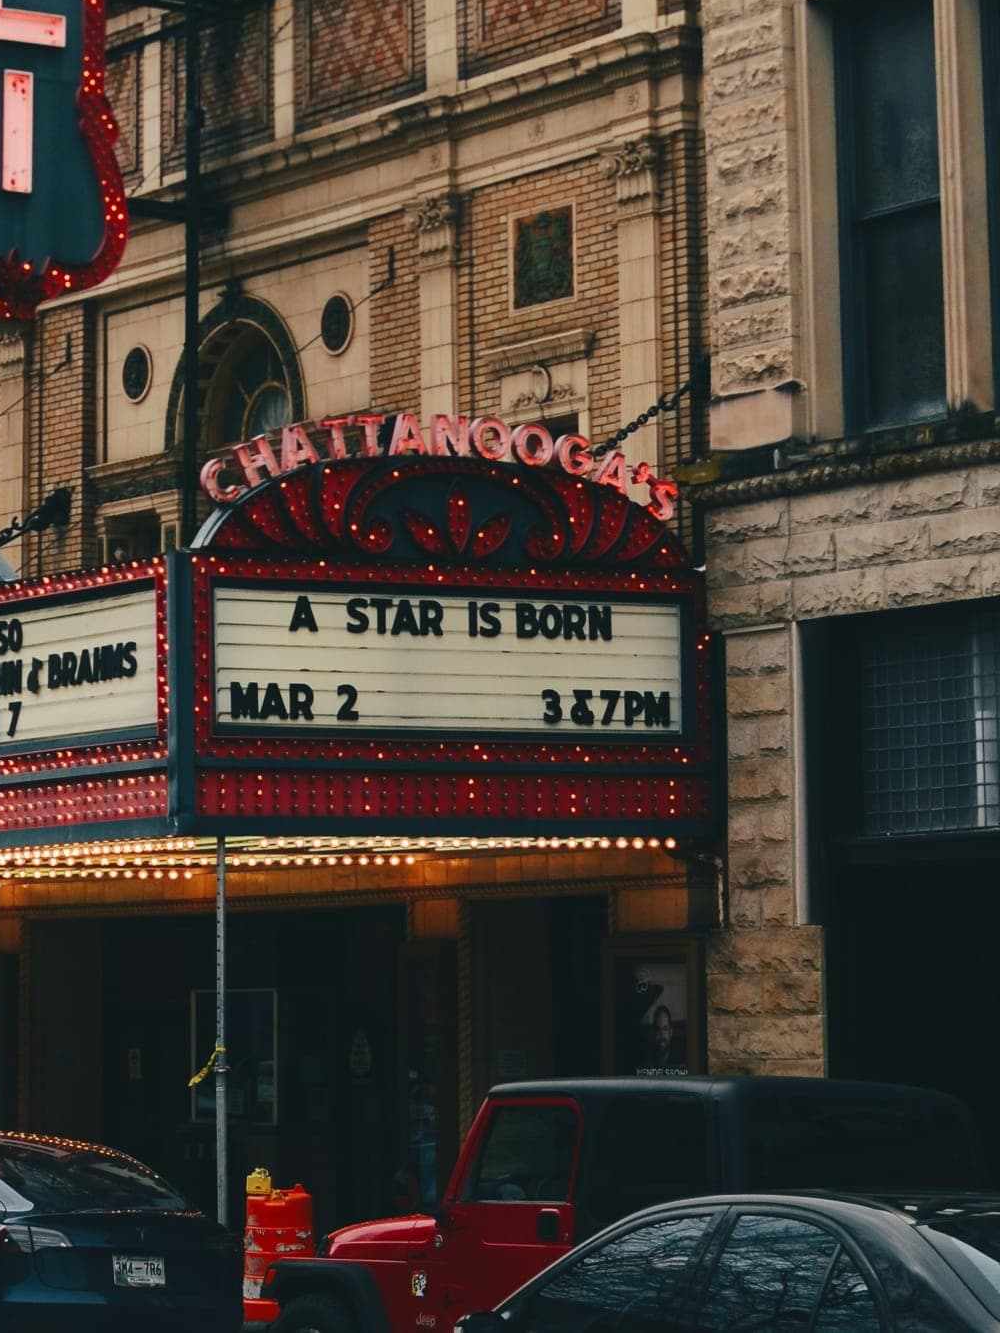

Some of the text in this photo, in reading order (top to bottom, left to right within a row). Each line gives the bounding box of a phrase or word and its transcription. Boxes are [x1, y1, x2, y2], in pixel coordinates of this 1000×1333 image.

[199, 412, 679, 521] CHATTANOOGA'S
[289, 595, 613, 642] A STAR IS BORN
[47, 641, 138, 690] BRAHMS
[7, 700, 22, 738] 7
[229, 681, 315, 721] MAR
[336, 684, 360, 722] 2
